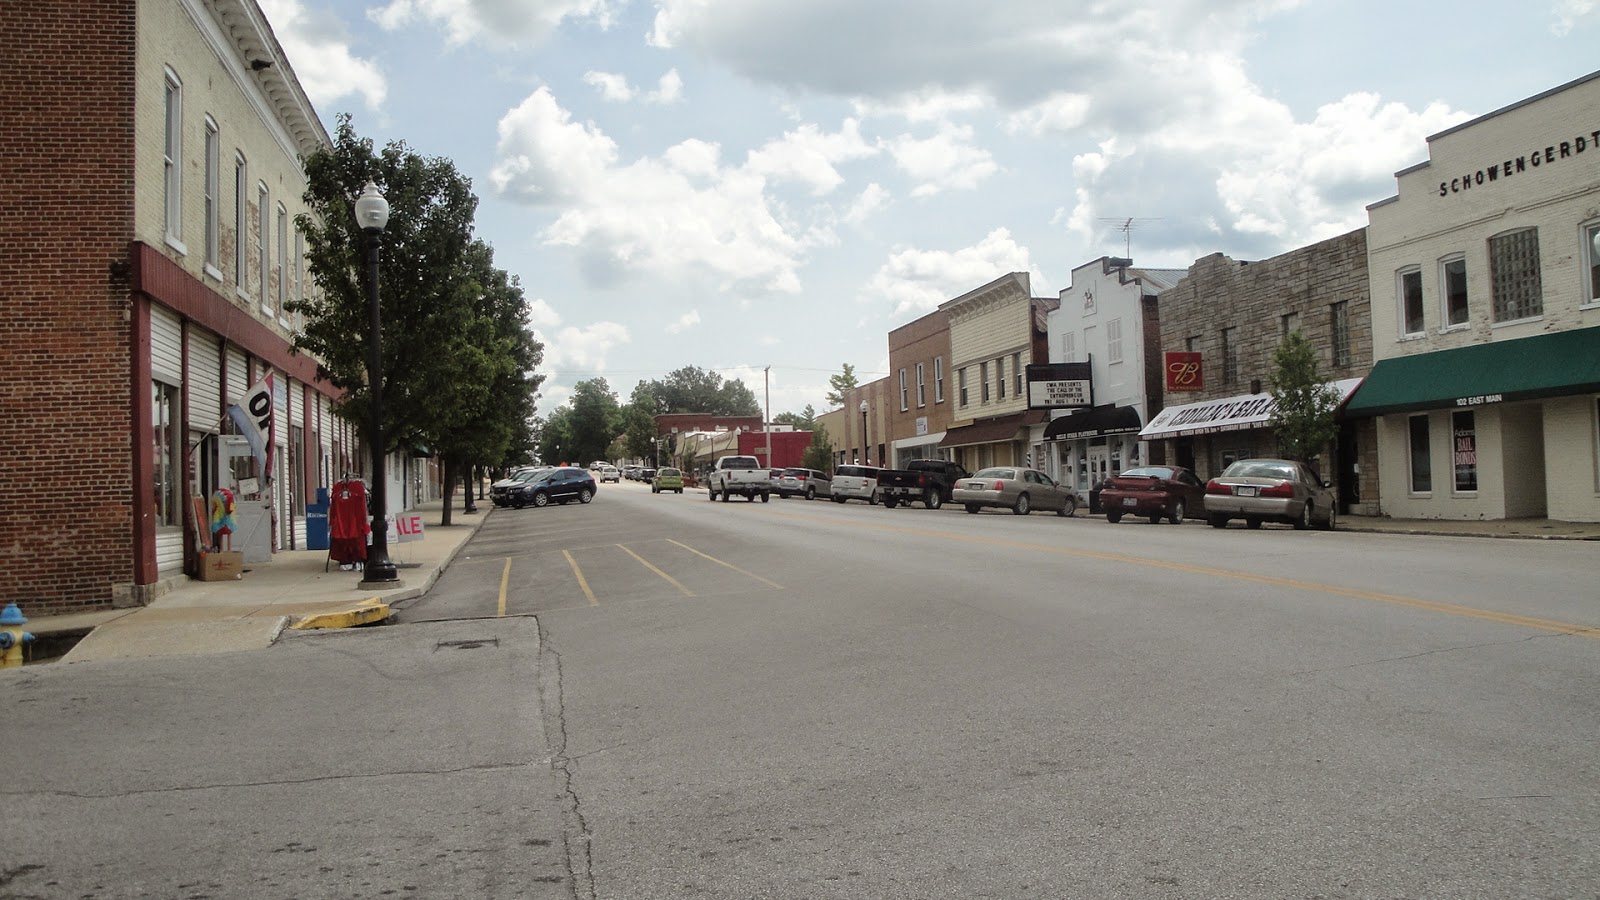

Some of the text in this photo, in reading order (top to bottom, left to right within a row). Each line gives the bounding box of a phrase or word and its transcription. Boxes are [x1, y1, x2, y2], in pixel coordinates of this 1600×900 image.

[1440, 130, 1600, 197] SCHOWENGERDT
[1457, 394, 1502, 406] 102 EAST MAIN
[1167, 402, 1240, 427] CADILLAC'S
[1229, 398, 1267, 418] BAR
[1457, 437, 1473, 451] BAIL
[1456, 451, 1477, 465] BONDS
